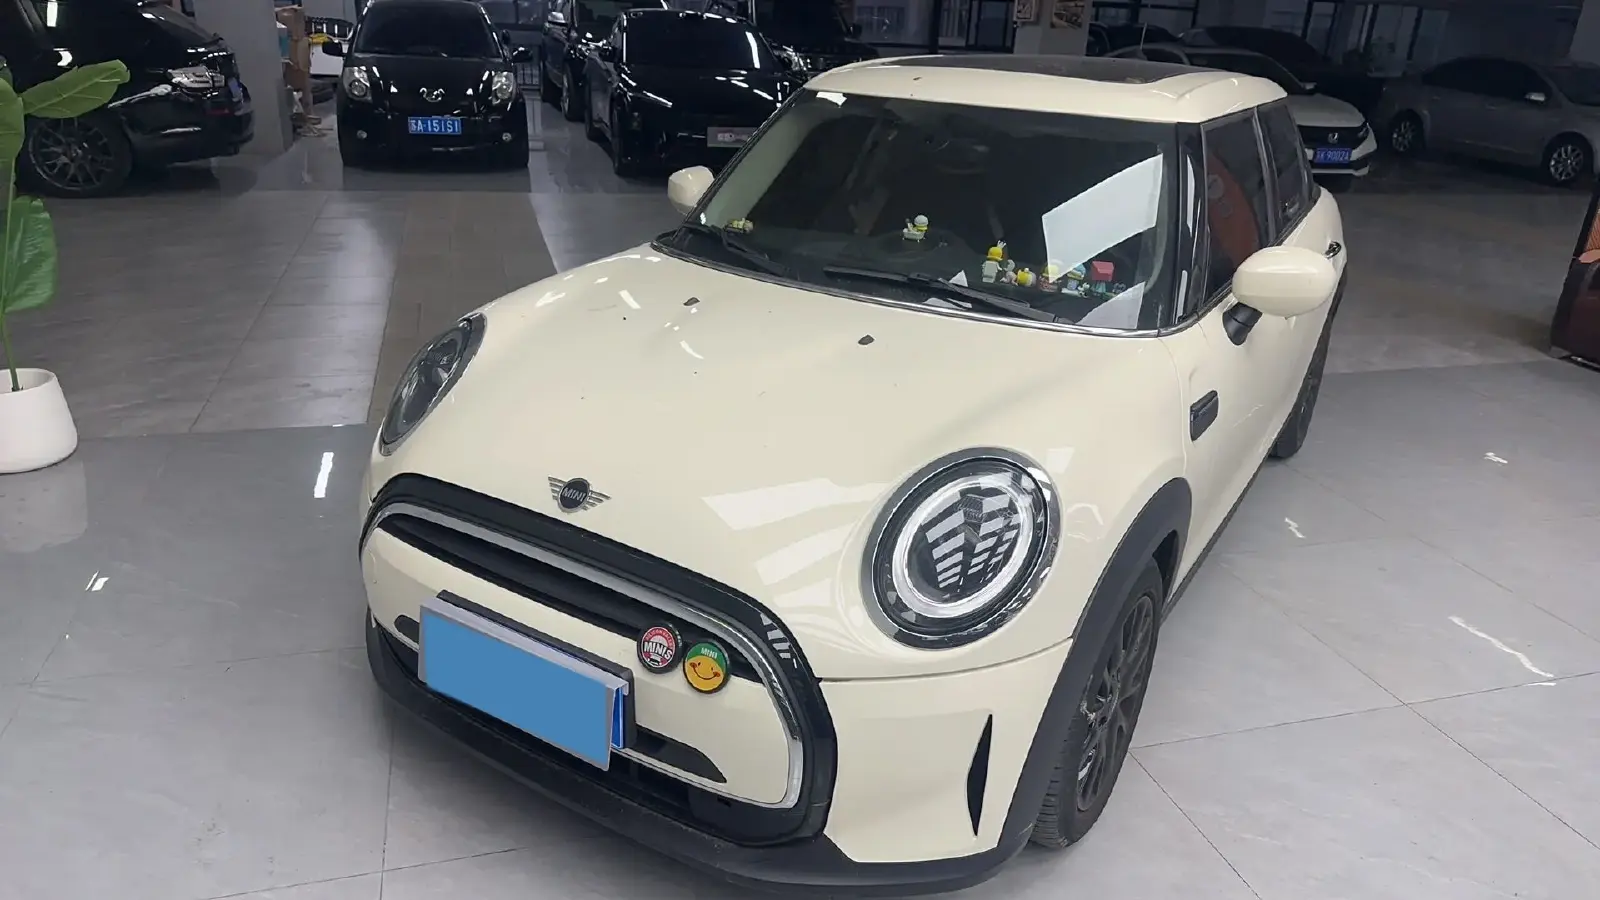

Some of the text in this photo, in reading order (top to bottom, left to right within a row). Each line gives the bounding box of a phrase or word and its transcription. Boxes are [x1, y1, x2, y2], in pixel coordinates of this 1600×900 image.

[561, 487, 587, 502] MINI
[643, 641, 674, 661] MINIS
[700, 647, 718, 659] MINI
